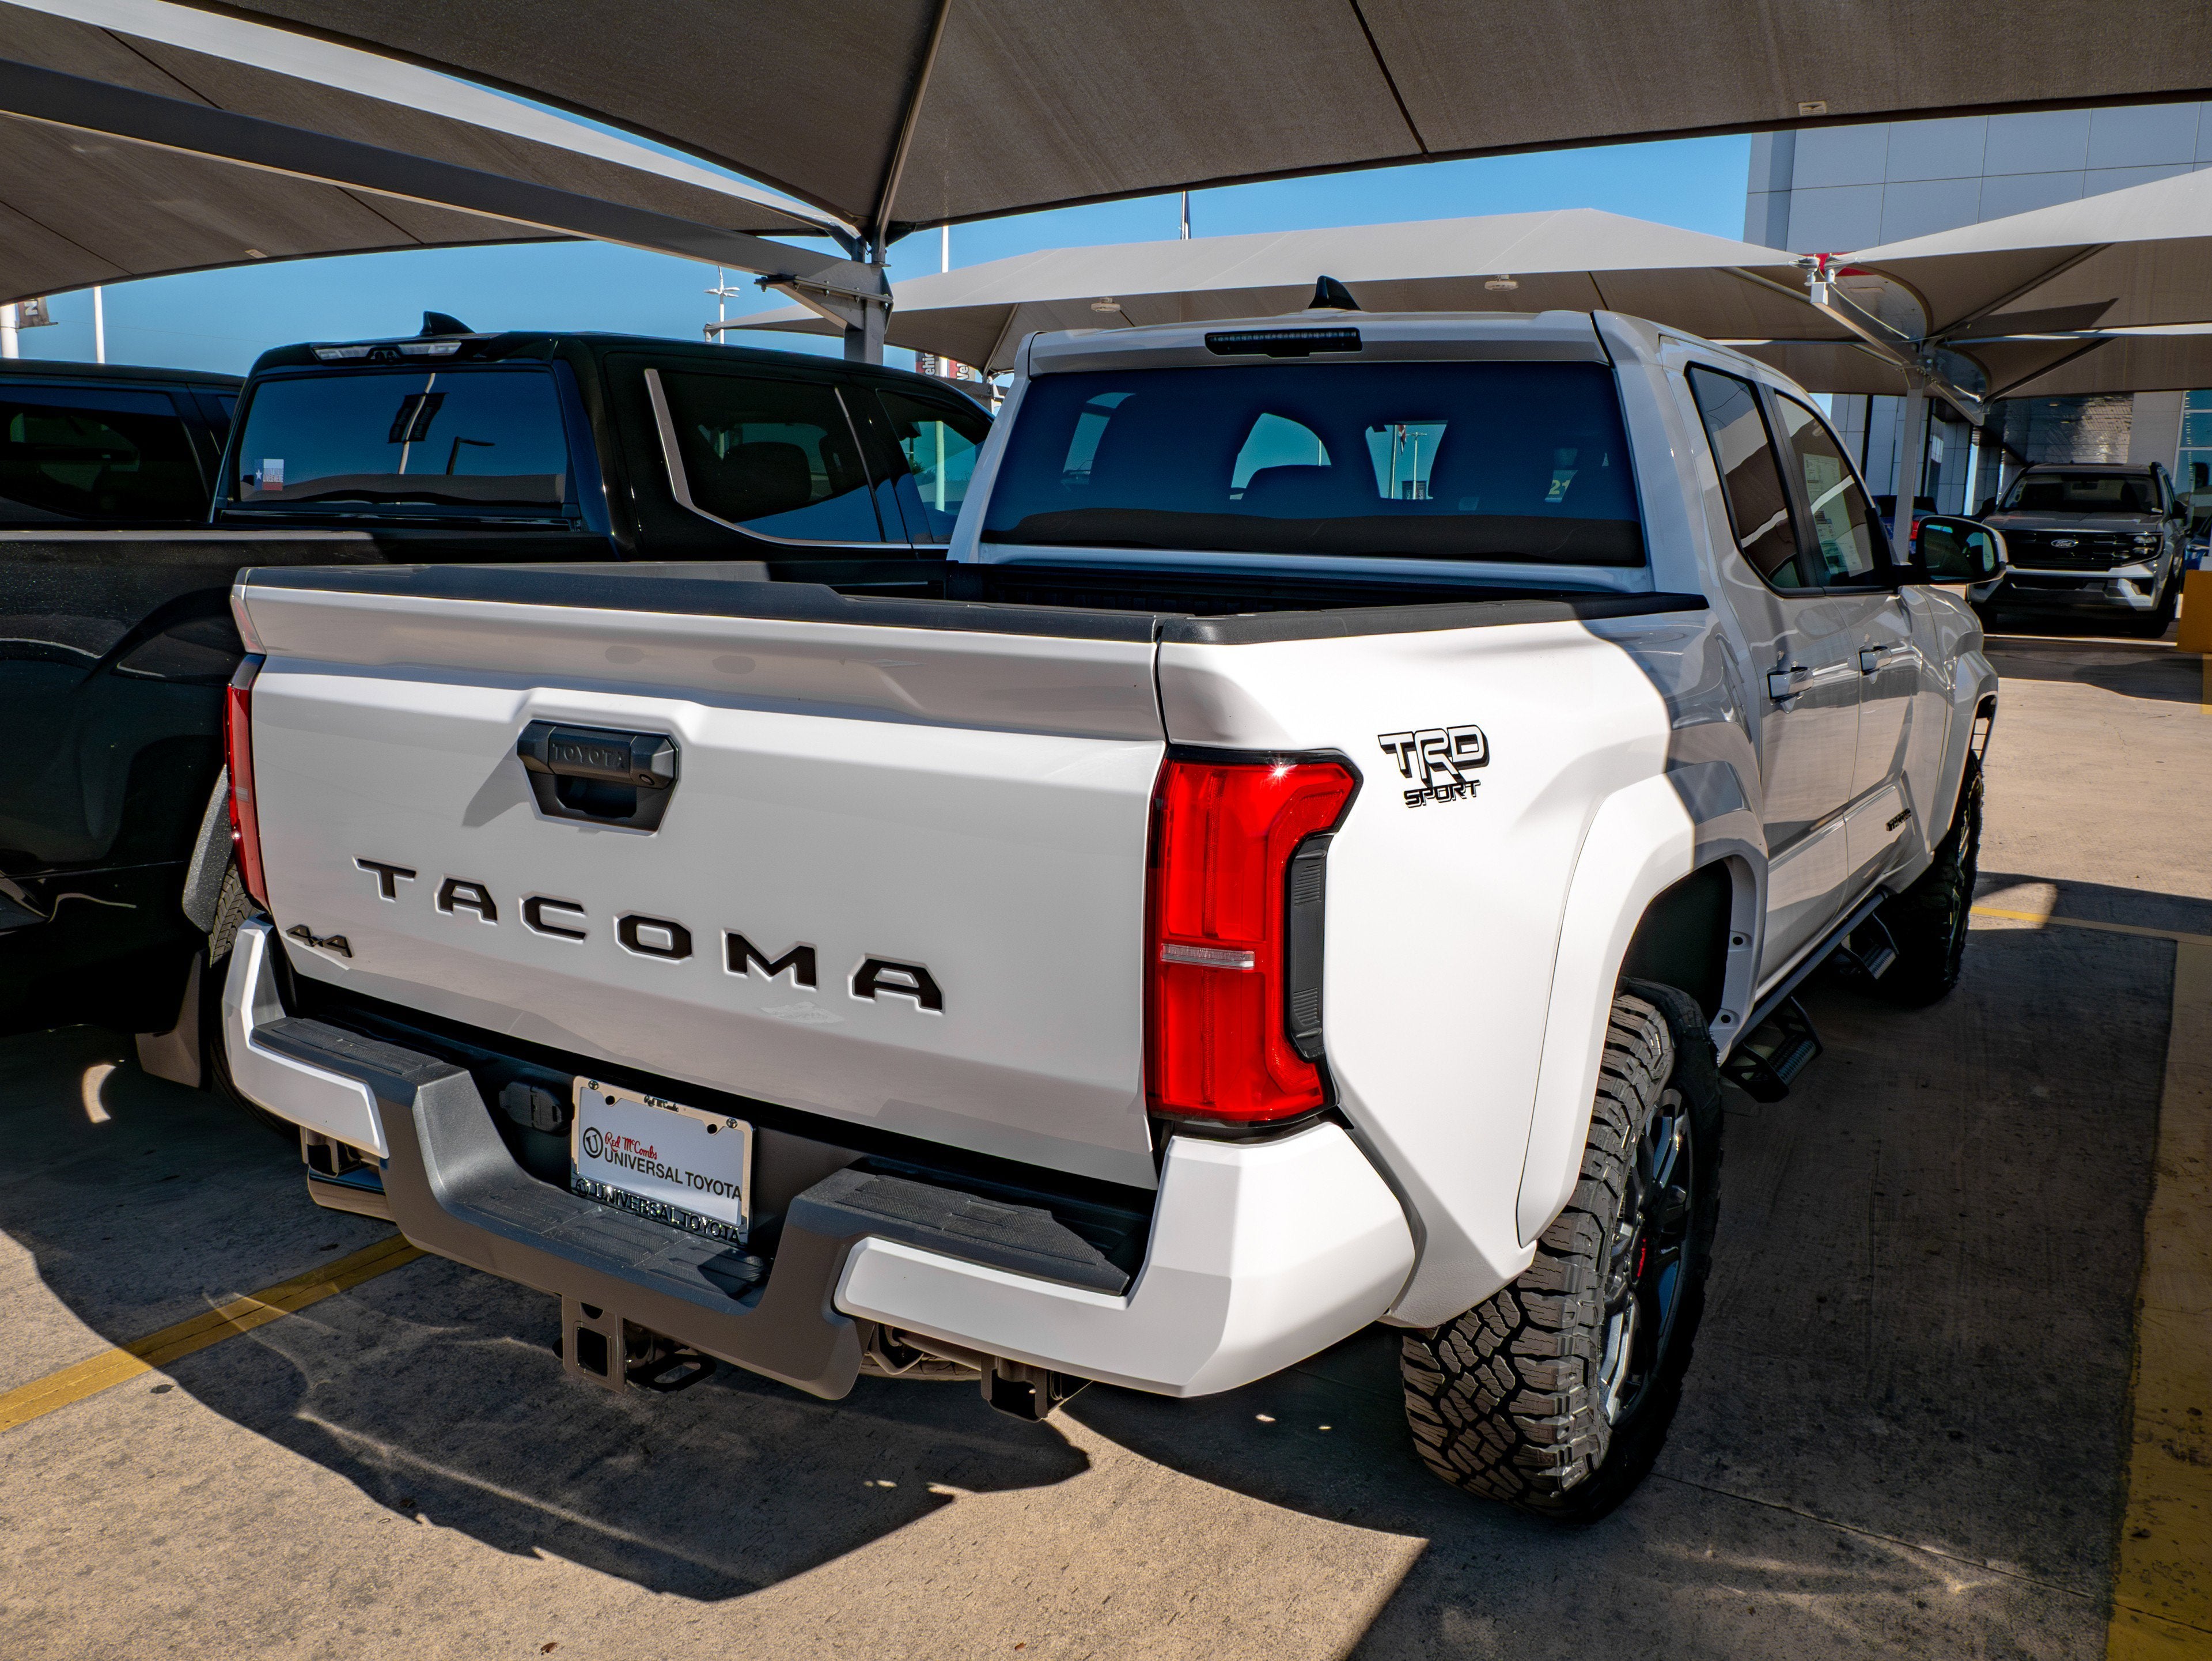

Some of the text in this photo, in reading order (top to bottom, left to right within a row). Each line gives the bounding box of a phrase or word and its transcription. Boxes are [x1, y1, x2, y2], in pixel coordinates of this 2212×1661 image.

[552, 743, 626, 769] TOYOTA
[1377, 724, 1490, 788] TRD
[1403, 780, 1481, 808] SPORT
[352, 854, 947, 1015] TACOMA
[605, 1132, 657, 1160] Red McCombs
[605, 1148, 742, 1201] UNIVERSAL TOYOTA
[595, 1183, 679, 1224] UNIVERSAL
[679, 1212, 742, 1244] TOYOTA
